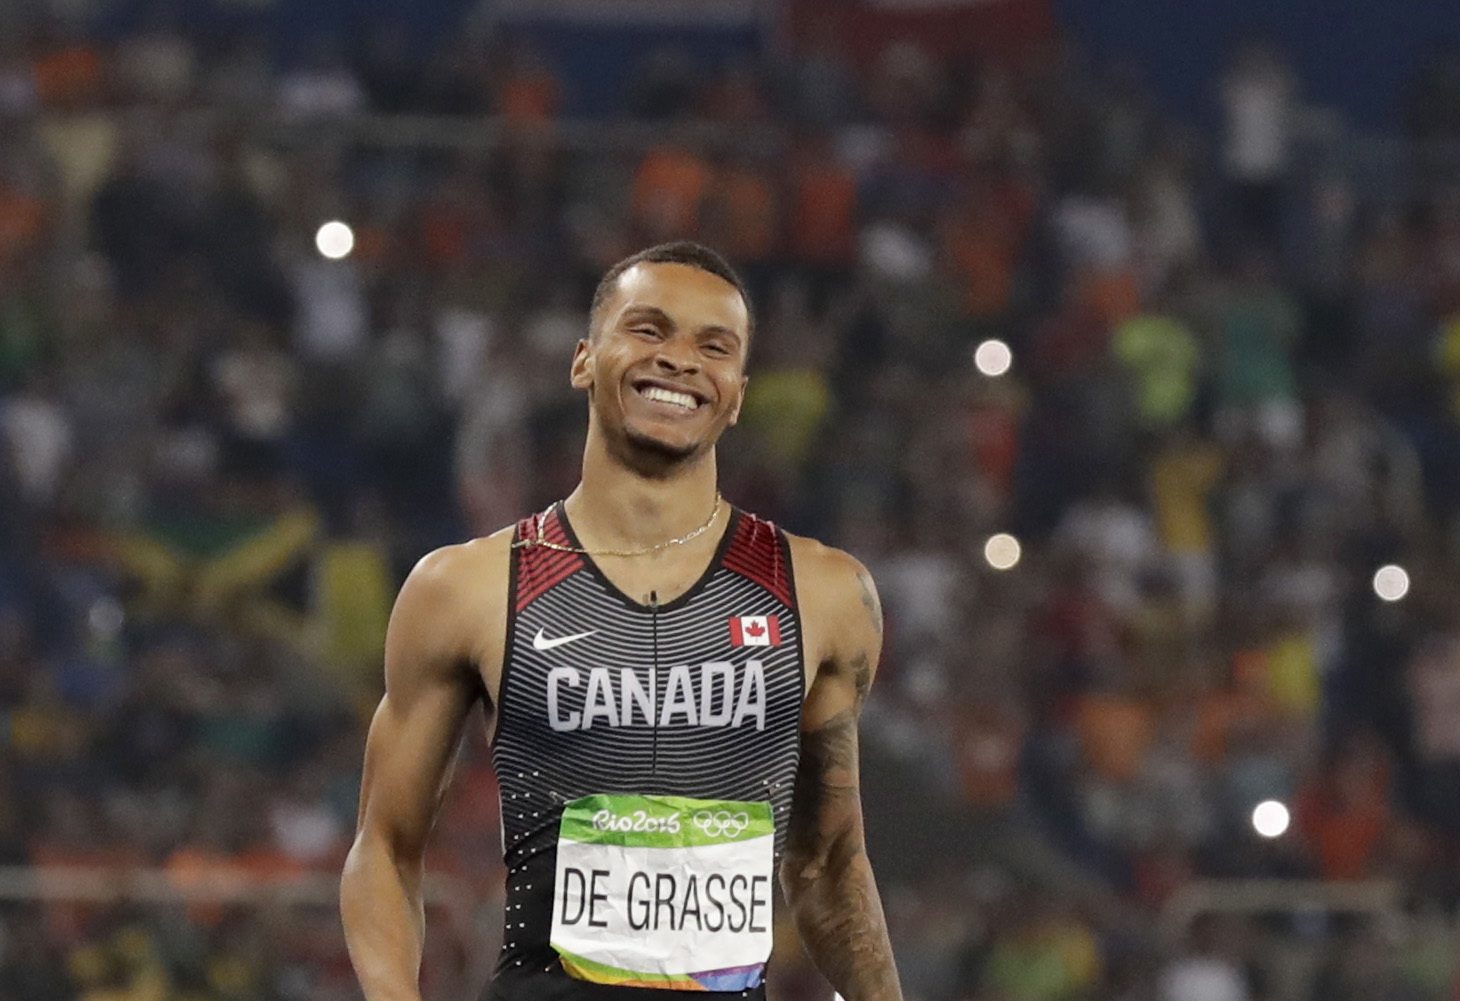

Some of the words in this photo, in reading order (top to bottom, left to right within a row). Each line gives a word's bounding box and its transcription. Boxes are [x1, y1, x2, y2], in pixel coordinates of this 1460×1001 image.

[547, 660, 766, 732] CANADA
[561, 868, 610, 927] DE
[627, 871, 767, 932] GRASSE
